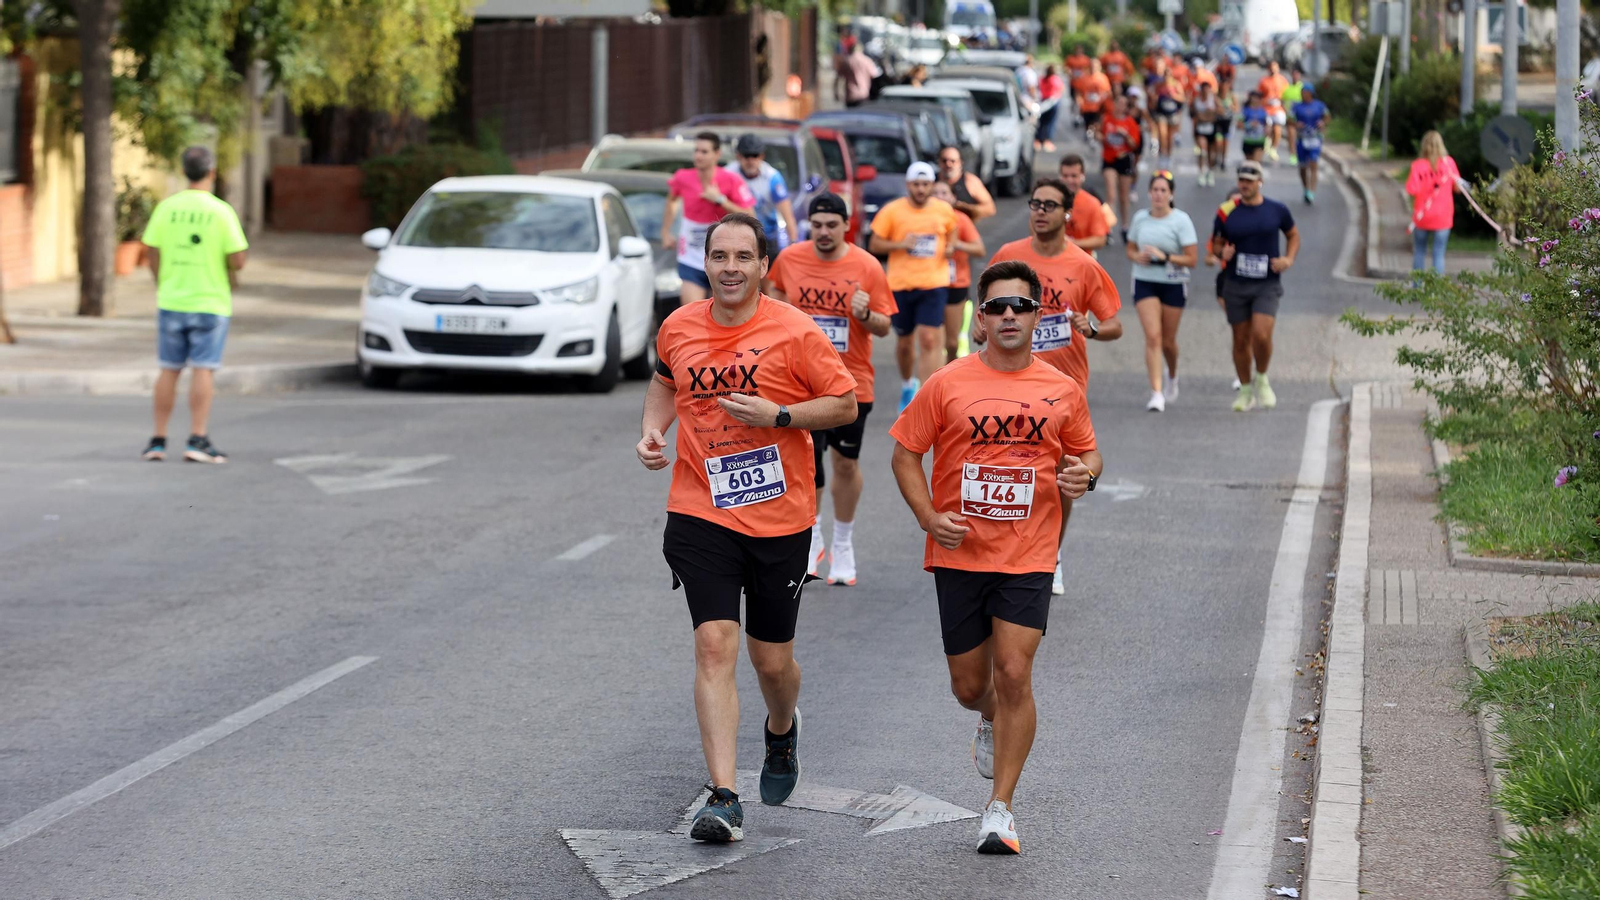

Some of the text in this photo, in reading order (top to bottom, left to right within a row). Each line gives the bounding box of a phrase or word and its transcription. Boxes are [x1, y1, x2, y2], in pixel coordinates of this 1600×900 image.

[799, 287, 847, 308] XXIX
[1035, 326, 1060, 340] 935
[687, 365, 759, 391] XXIX
[968, 415, 1048, 440] XXIX
[729, 467, 766, 490] 603
[980, 484, 1016, 503] 146
